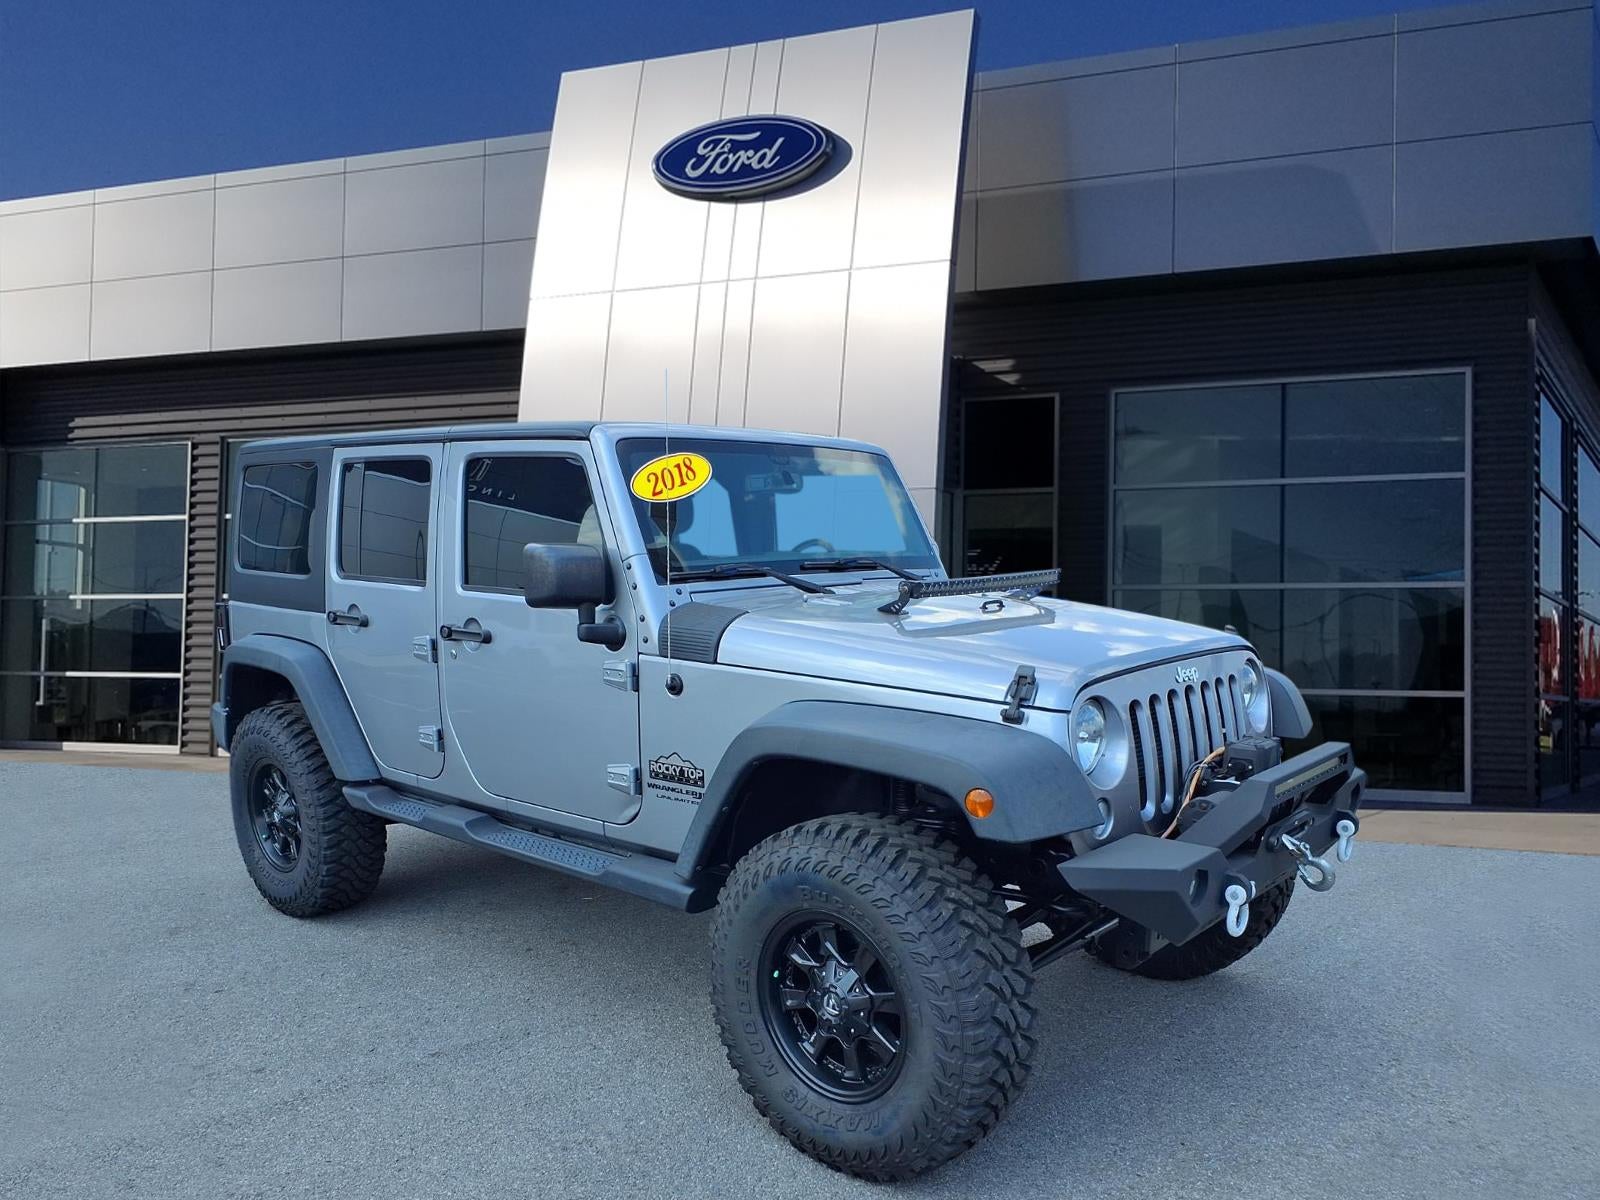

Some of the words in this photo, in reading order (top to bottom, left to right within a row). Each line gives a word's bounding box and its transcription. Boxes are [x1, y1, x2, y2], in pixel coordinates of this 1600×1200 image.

[685, 131, 784, 178] Ford
[646, 456, 697, 497] 2018
[1175, 666, 1198, 682] Jeep
[650, 761, 681, 776] ROCKY
[682, 766, 703, 780] TOP
[647, 782, 698, 798] WRANGLER
